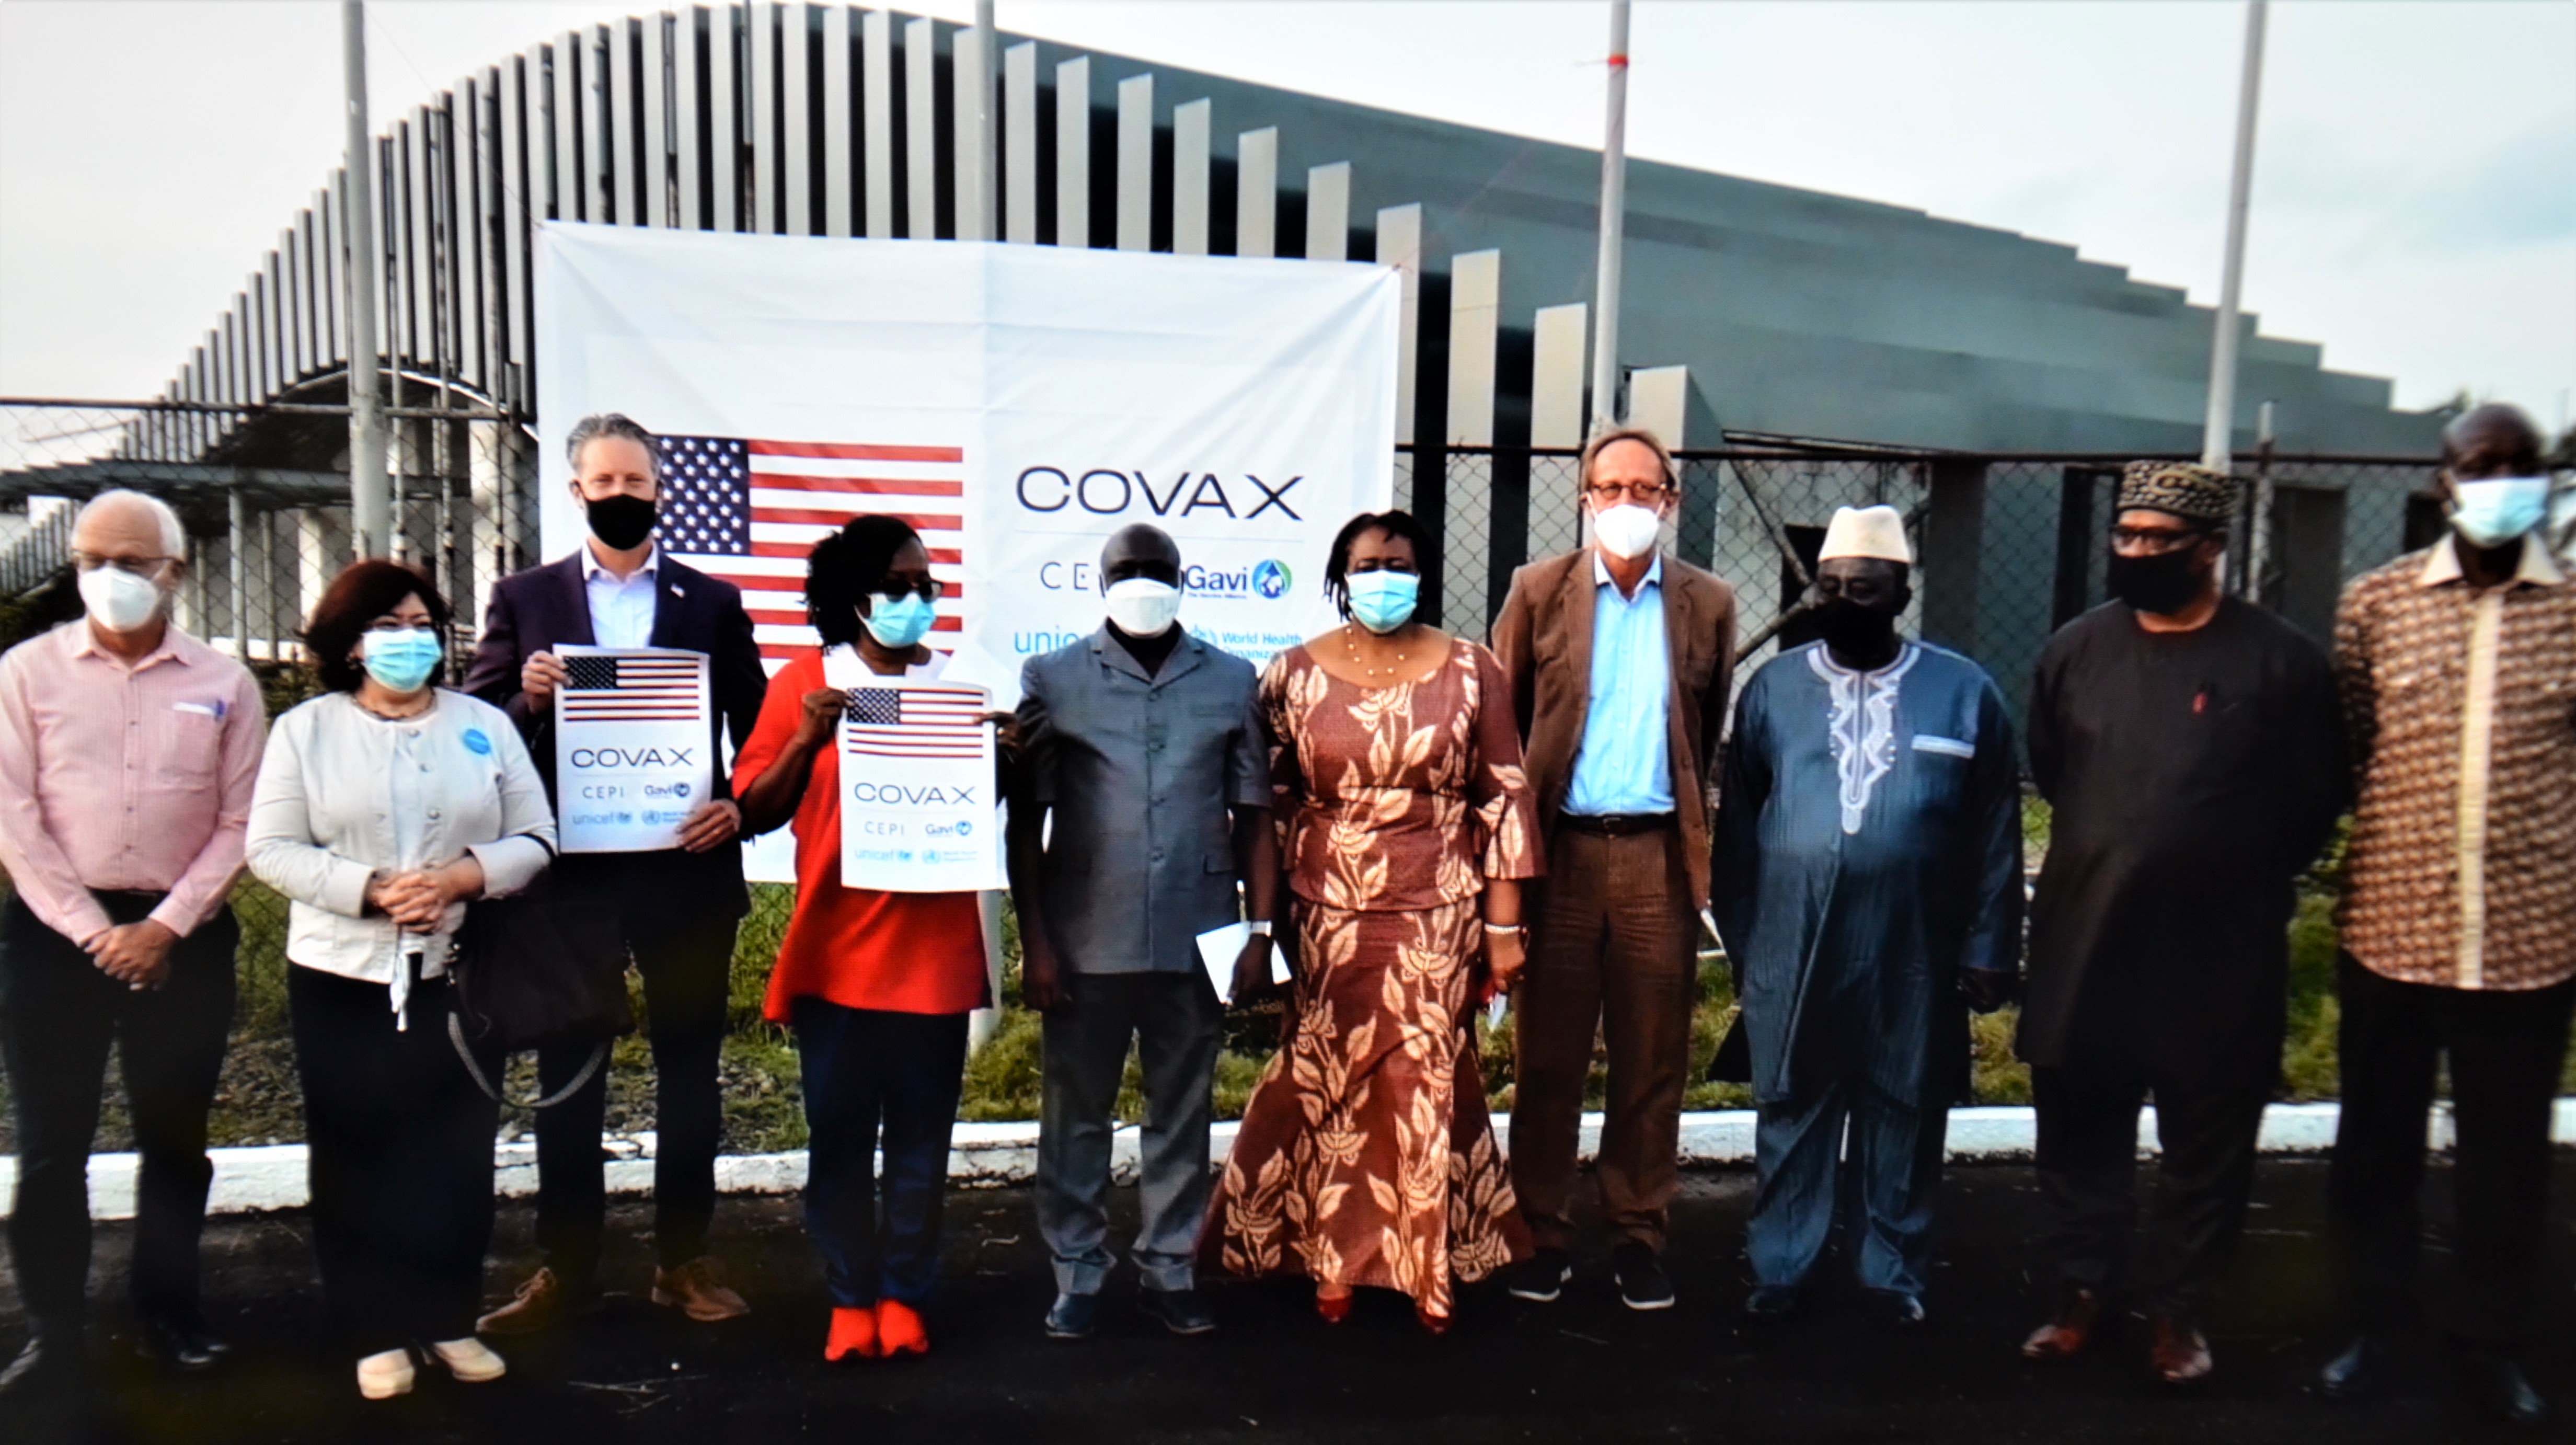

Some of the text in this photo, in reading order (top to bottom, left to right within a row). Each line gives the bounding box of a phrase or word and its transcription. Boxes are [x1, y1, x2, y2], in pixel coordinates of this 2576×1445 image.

[1016, 466, 1304, 522] COVAX
[1040, 561, 1089, 590] CE
[1184, 565, 1248, 591] Gavi
[1015, 625, 1080, 653] unic
[1222, 633, 1303, 646] World Health
[571, 748, 694, 769] COVAX
[582, 786, 625, 799] CEPI
[854, 783, 976, 805] COVAX
[864, 821, 904, 835] CEPI
